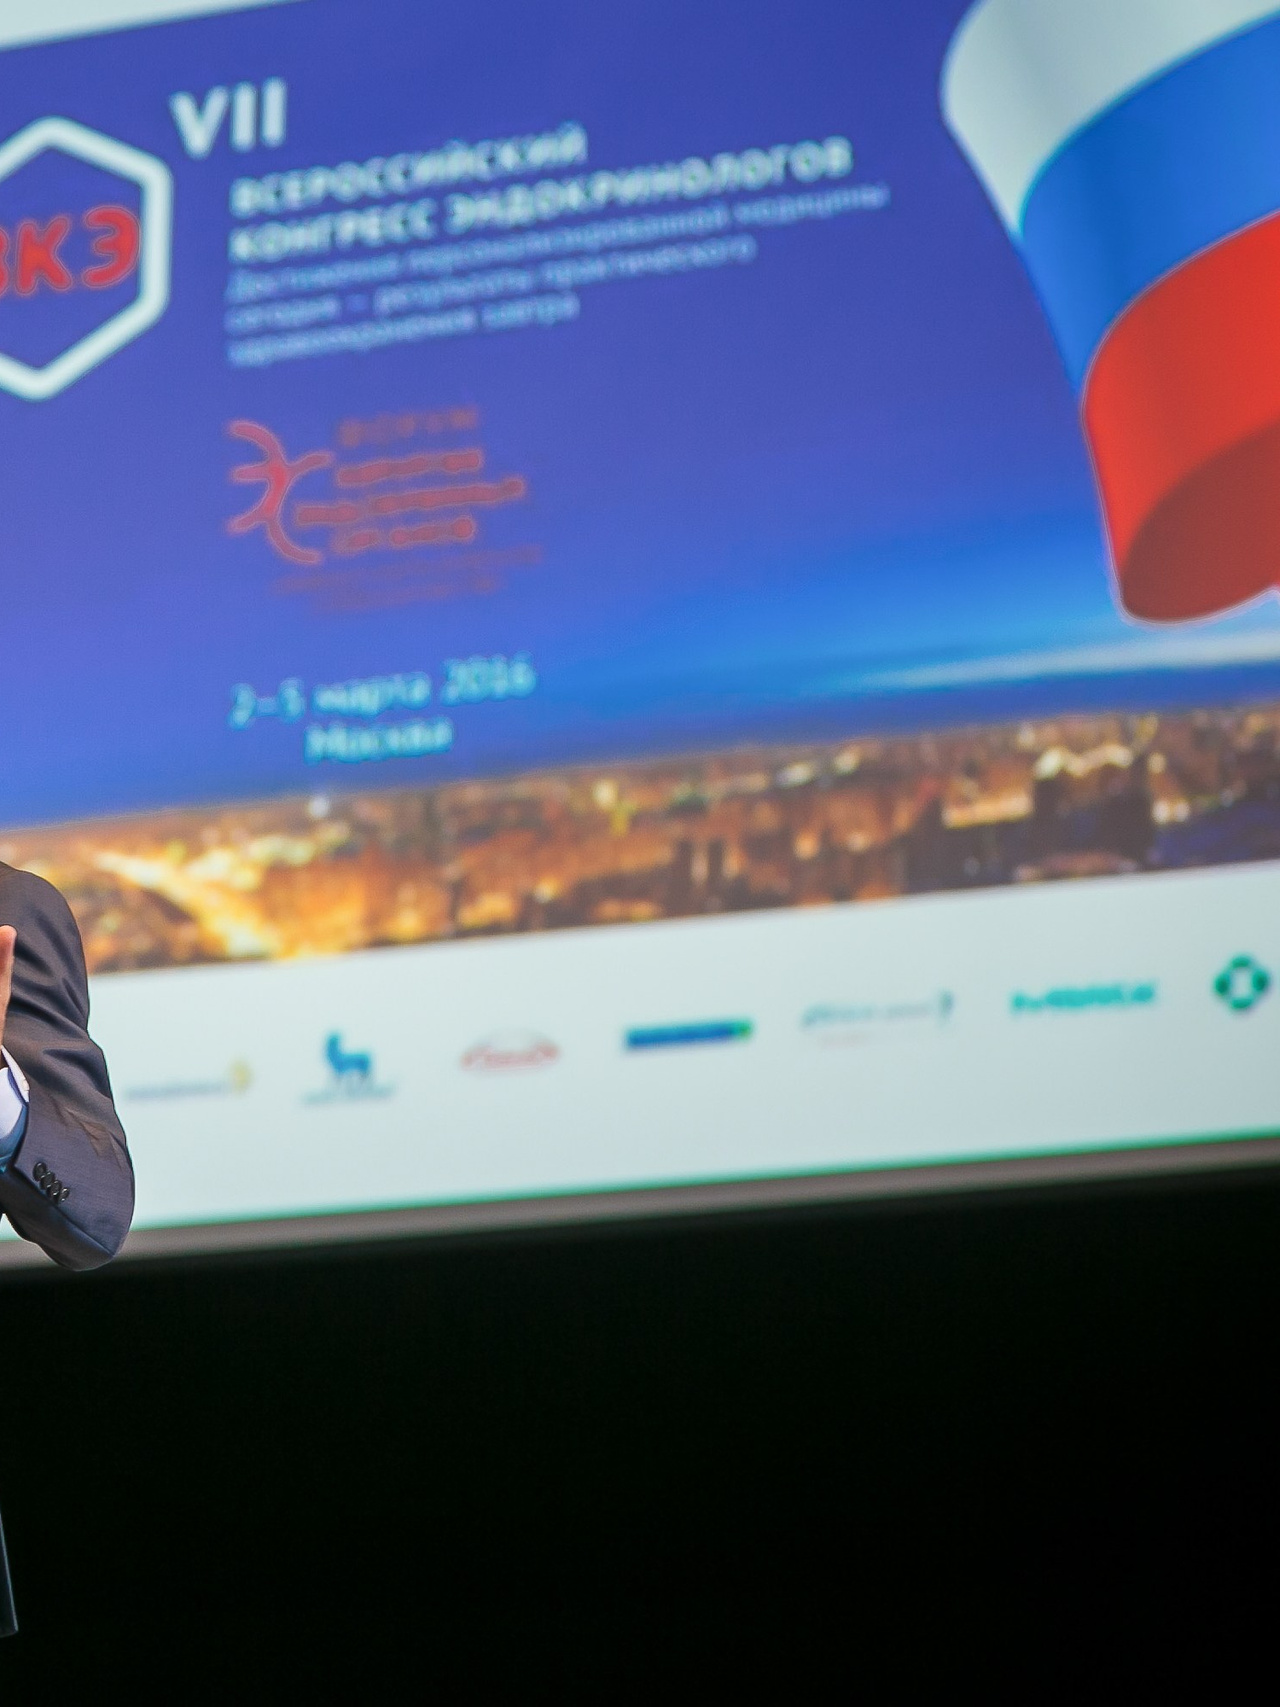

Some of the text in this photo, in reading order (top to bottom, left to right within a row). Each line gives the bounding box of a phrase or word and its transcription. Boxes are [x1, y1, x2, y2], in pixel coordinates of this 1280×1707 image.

[170, 77, 286, 160] VII
[228, 135, 854, 263] КОНГРЕСС ЭНДОКРИНОЛОГОВ
[230, 122, 588, 219] ВСЕРОССИЙСКИЙ
